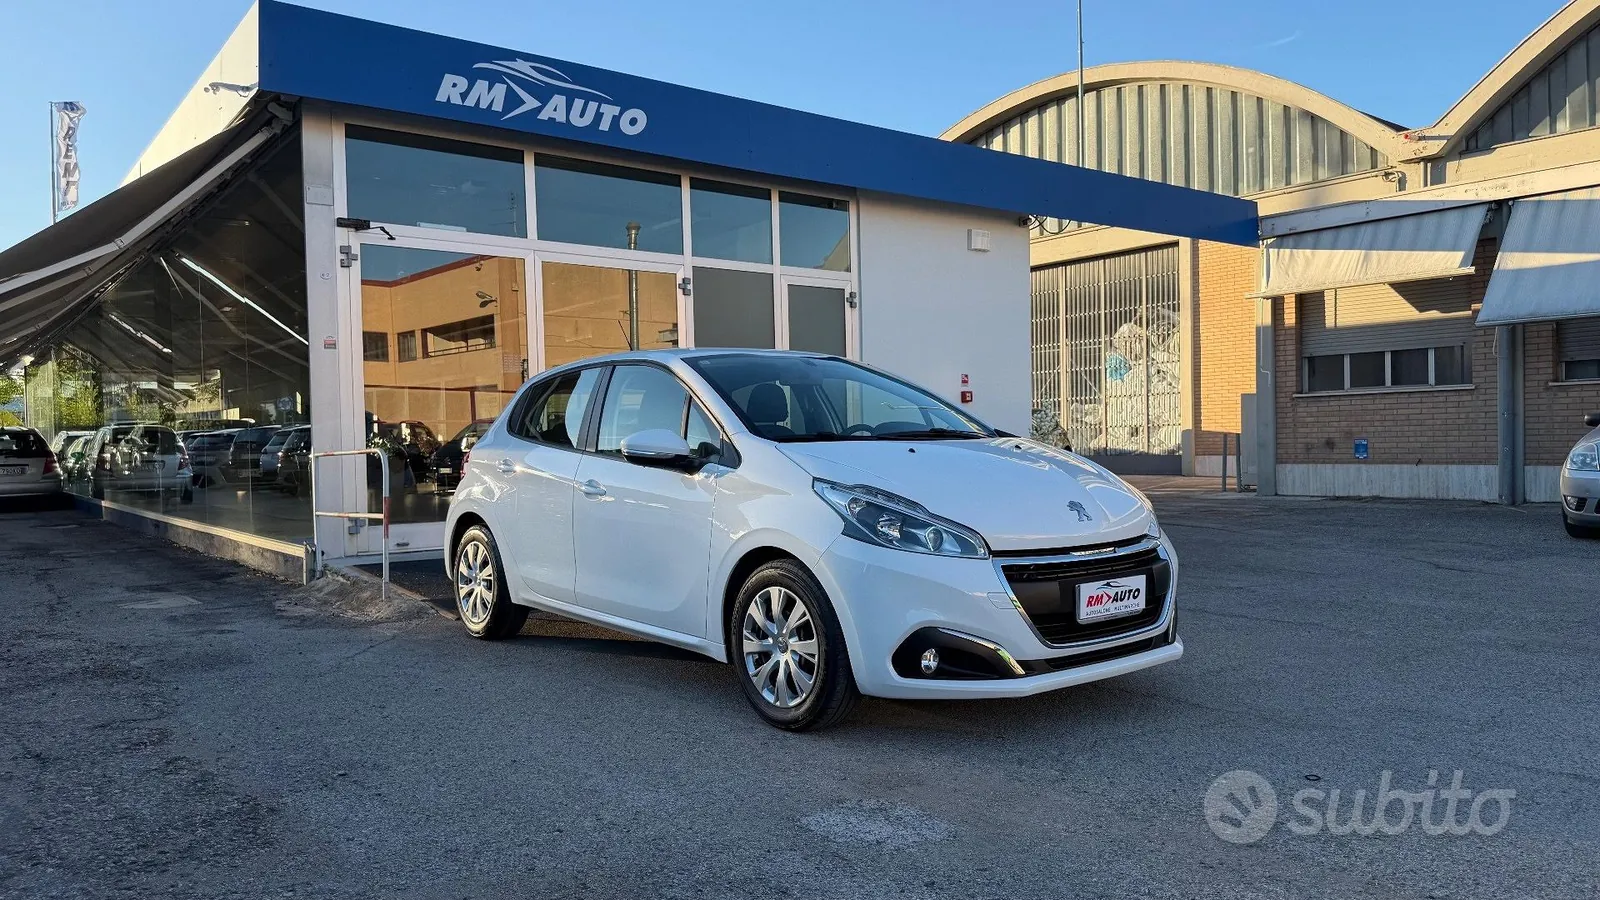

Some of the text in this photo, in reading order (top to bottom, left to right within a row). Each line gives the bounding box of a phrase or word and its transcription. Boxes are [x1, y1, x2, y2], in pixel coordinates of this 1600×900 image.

[435, 73, 648, 136] RM AUTO
[62, 126, 79, 197] RENT
[1086, 588, 1141, 608] RM AUTO
